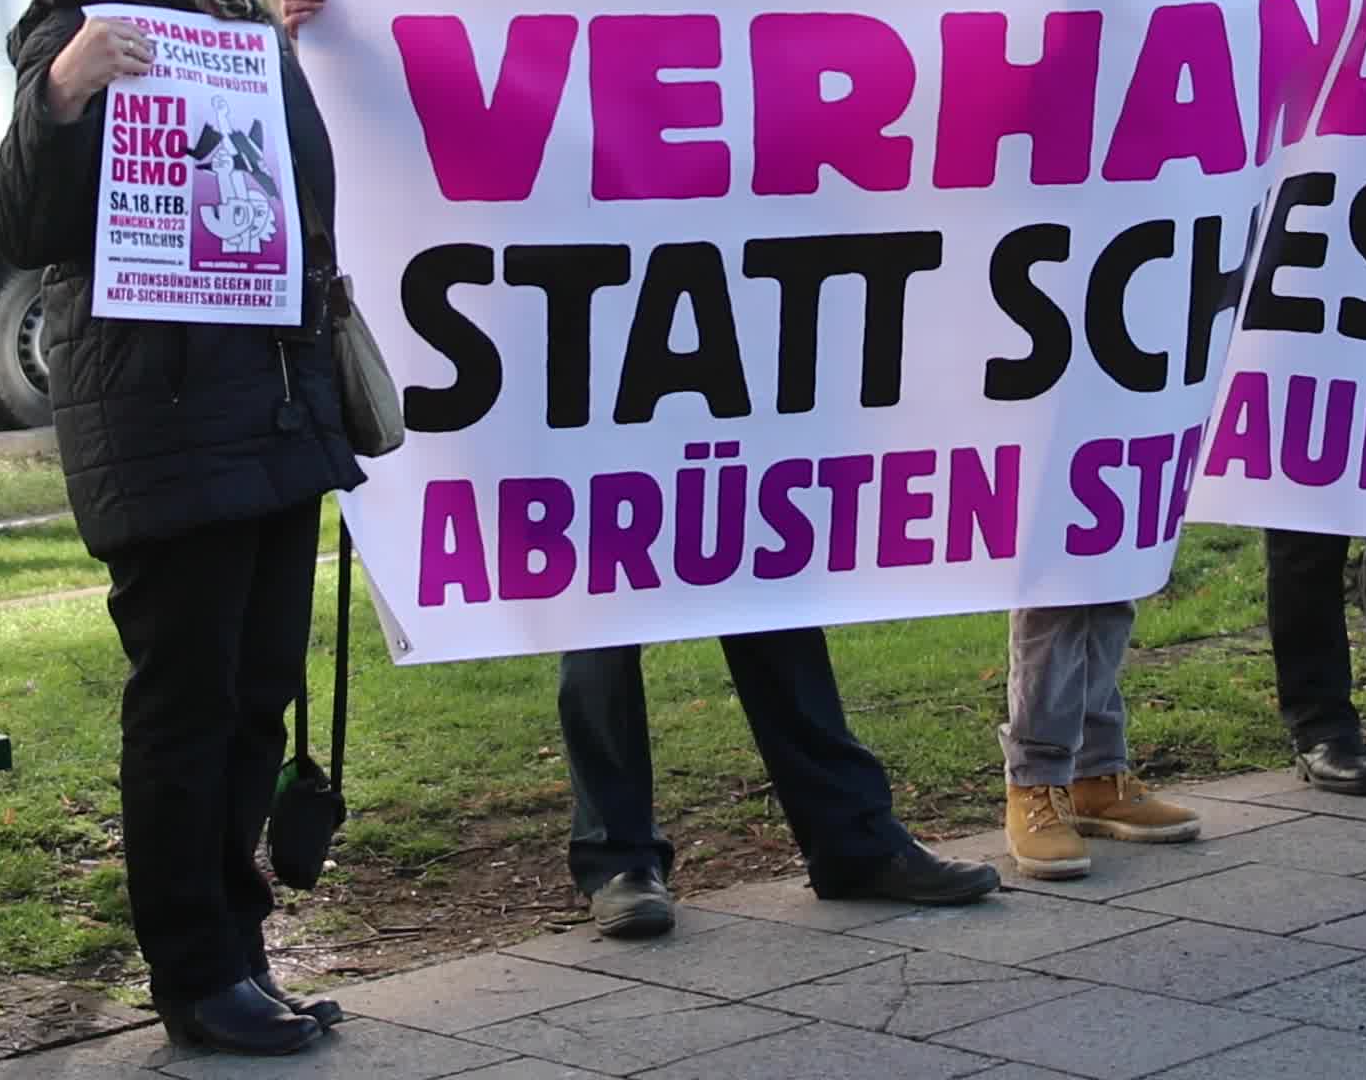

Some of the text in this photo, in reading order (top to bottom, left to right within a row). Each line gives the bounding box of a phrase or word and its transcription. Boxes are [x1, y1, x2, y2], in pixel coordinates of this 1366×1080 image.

[122, 17, 266, 52] RHANDELN
[163, 42, 266, 77] SCHIESSEN!
[112, 91, 187, 127] ANTI
[112, 124, 188, 160] SIKO
[111, 158, 187, 187] DEMO
[214, 278, 251, 291] GEGEN
[254, 279, 273, 292] DIE
[401, 231, 943, 433] STATT
[418, 441, 1022, 607] ABRÜSTEN
